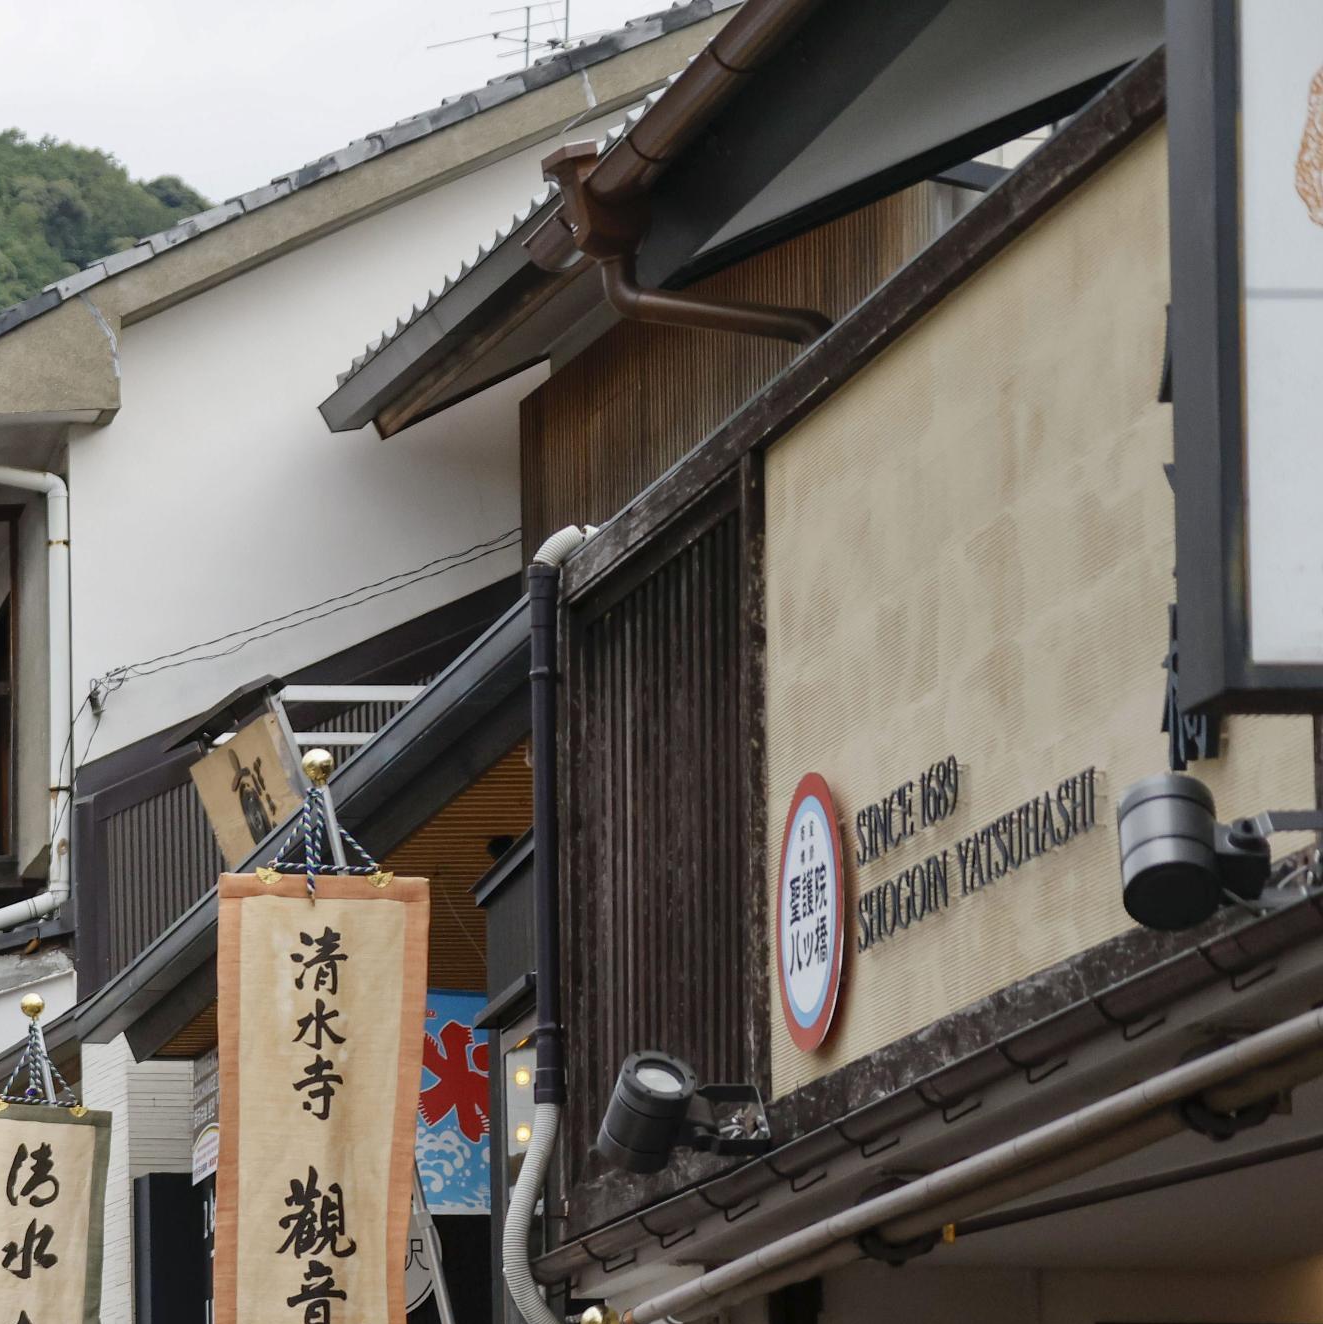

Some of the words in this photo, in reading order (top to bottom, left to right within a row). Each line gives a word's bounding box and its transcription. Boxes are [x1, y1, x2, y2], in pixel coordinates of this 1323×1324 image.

[857, 780, 915, 868] SINCE
[921, 754, 959, 829] 1689
[857, 850, 949, 954] SHOGOIN
[955, 766, 1097, 897] YATSUHASHI
[789, 861, 828, 927] 聖護院
[290, 926, 349, 1121] 清水寺
